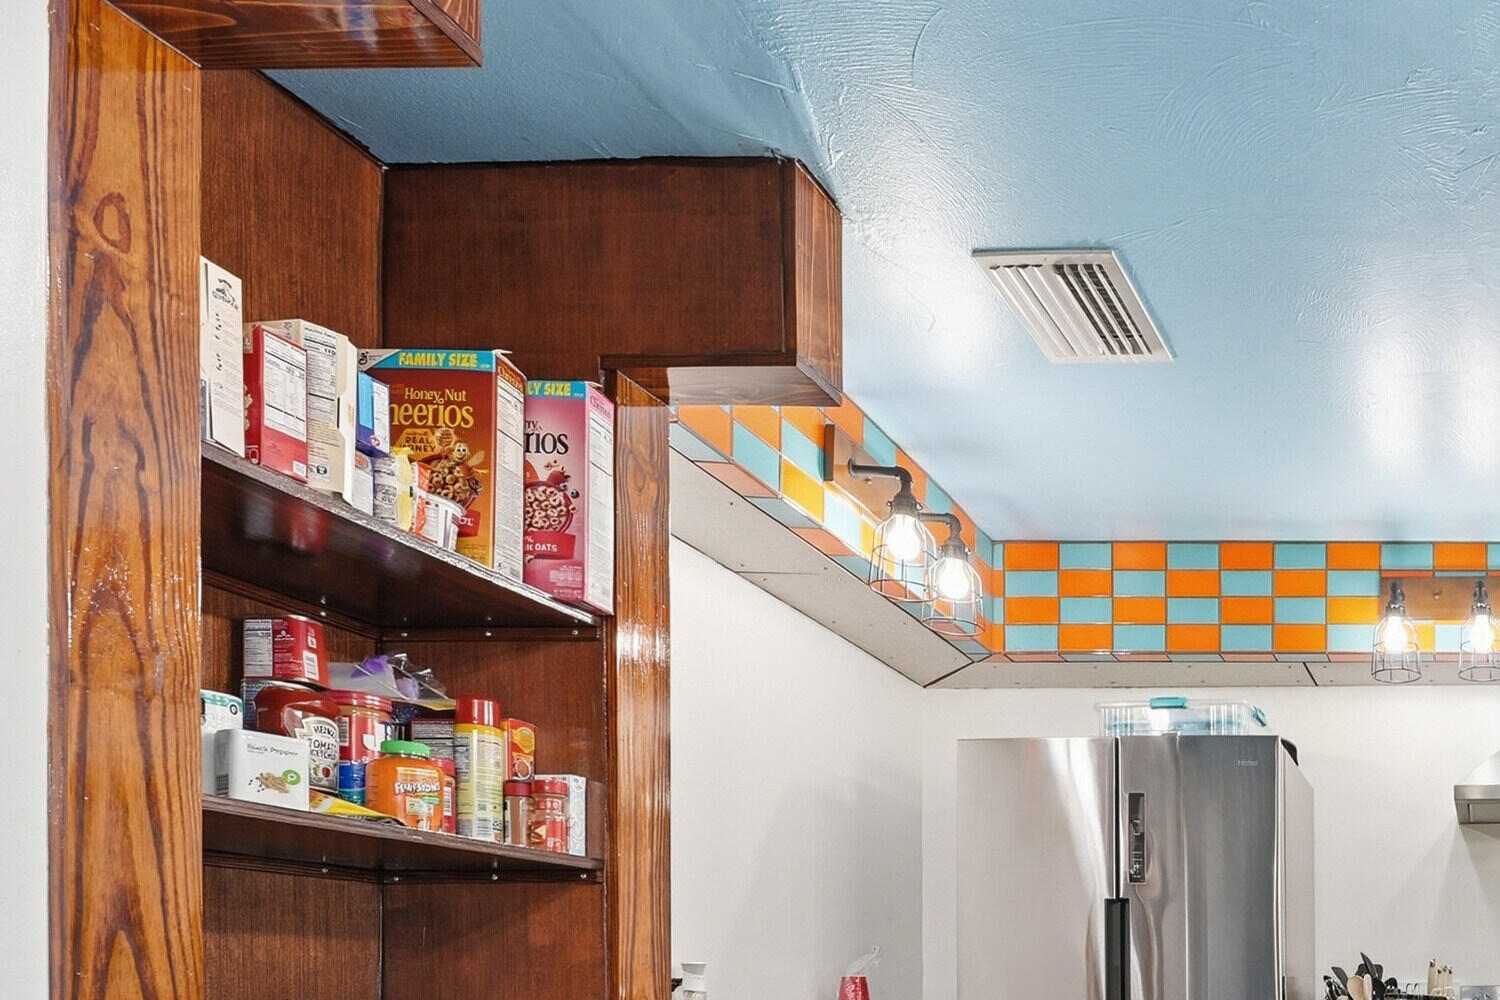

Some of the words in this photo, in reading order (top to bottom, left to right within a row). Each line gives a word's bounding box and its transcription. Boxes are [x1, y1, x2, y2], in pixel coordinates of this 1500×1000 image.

[398, 352, 446, 366] FAMILY
[448, 353, 478, 368] SIZE
[404, 387, 441, 401] Honey
[444, 389, 467, 402] Nut
[543, 383, 571, 396] SIZE
[389, 402, 475, 429] heerios
[405, 436, 430, 444] REAL
[525, 432, 569, 455] rios
[535, 543, 558, 552] OATS
[313, 725, 336, 737] HEINZ
